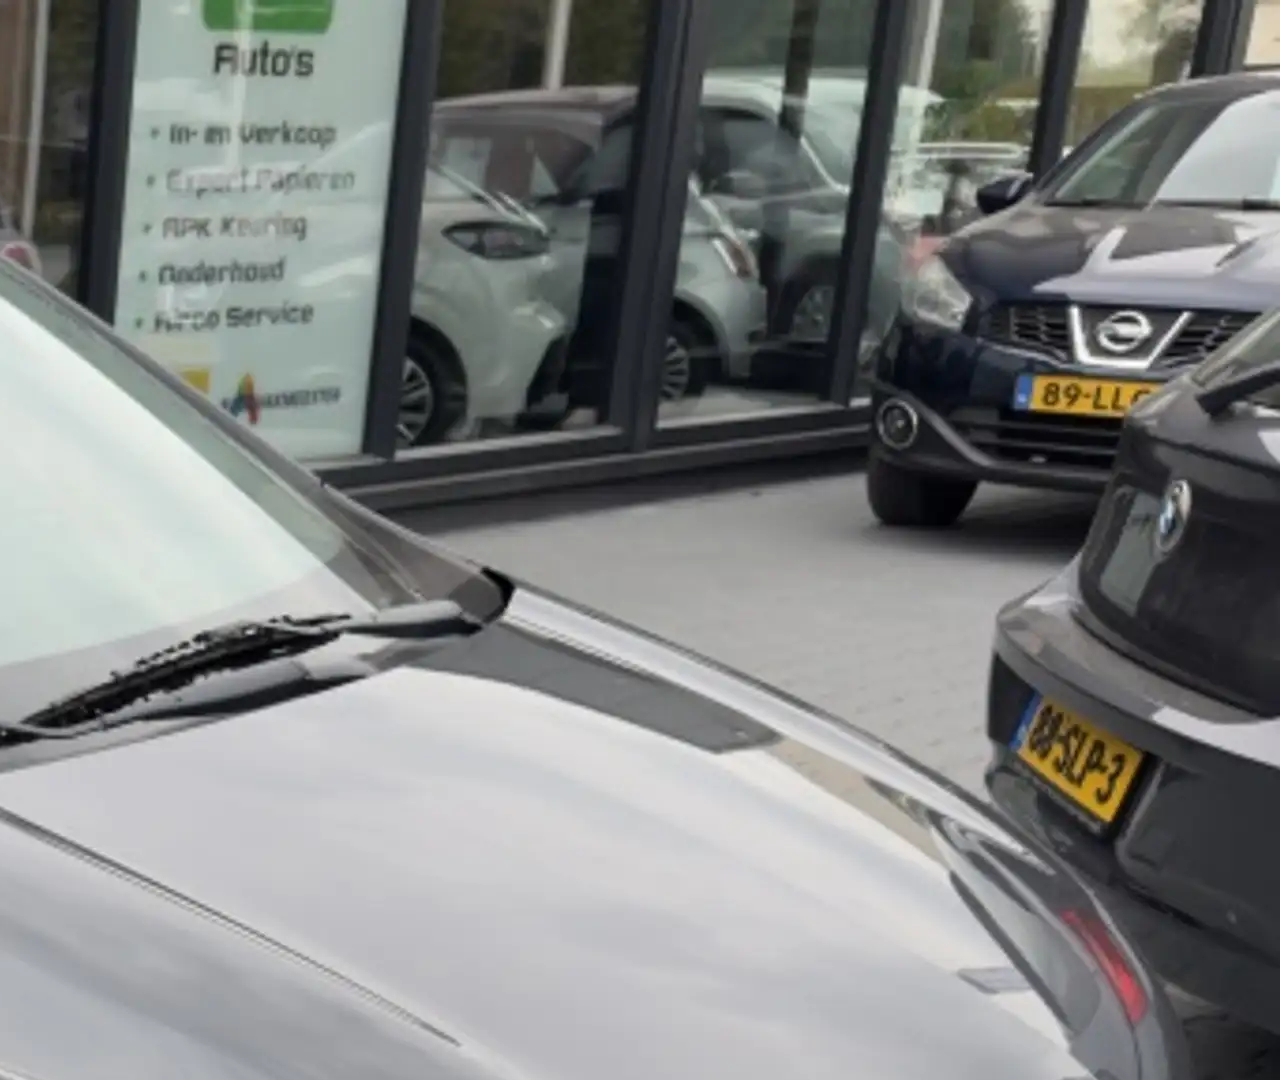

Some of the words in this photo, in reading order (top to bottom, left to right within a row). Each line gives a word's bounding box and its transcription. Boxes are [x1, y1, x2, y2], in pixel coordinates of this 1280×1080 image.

[213, 40, 314, 77] Auto's
[162, 216, 212, 239] APK
[158, 255, 287, 286] Onderhoud
[226, 302, 315, 328] Service
